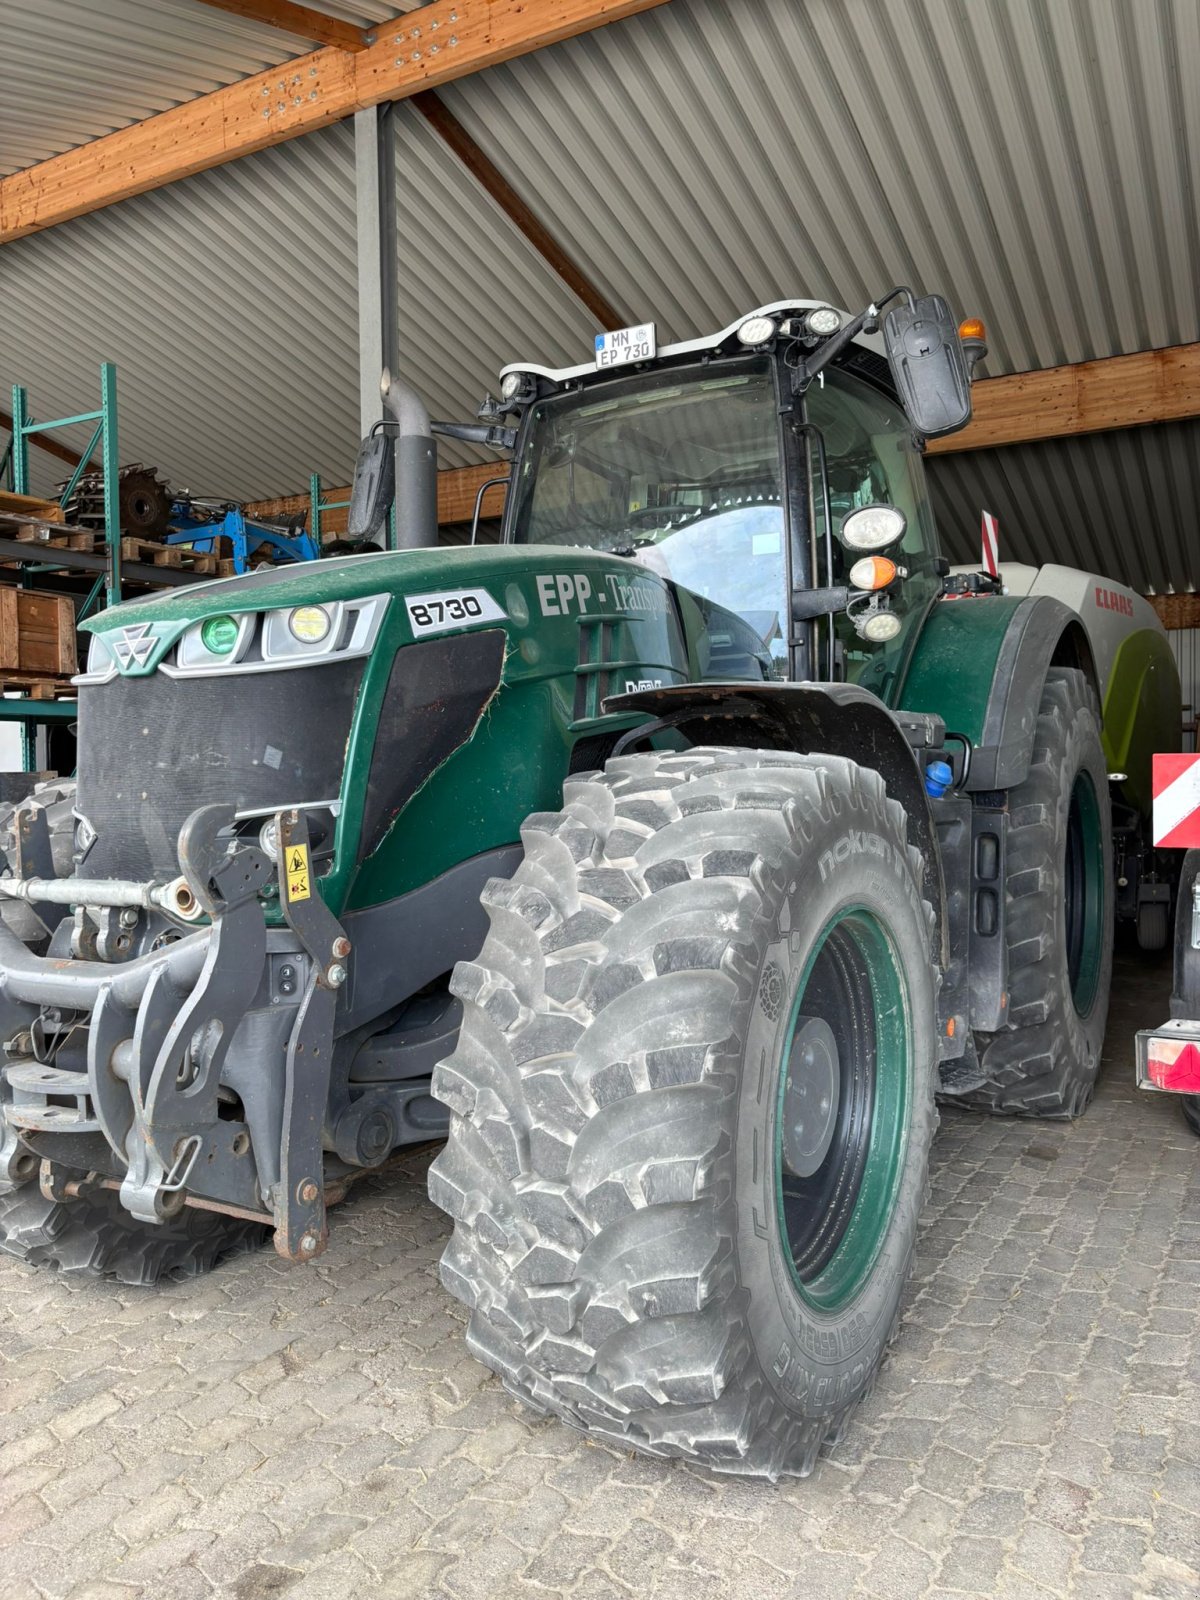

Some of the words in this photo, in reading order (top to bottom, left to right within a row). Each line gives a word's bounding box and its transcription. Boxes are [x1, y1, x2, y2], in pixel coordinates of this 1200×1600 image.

[600, 350, 618, 366] EP
[624, 342, 650, 361] 730
[611, 331, 629, 348] MN
[409, 595, 483, 627] 8730
[535, 574, 592, 617] EPP
[604, 574, 672, 621] Transp
[1095, 587, 1134, 617] CLAAS
